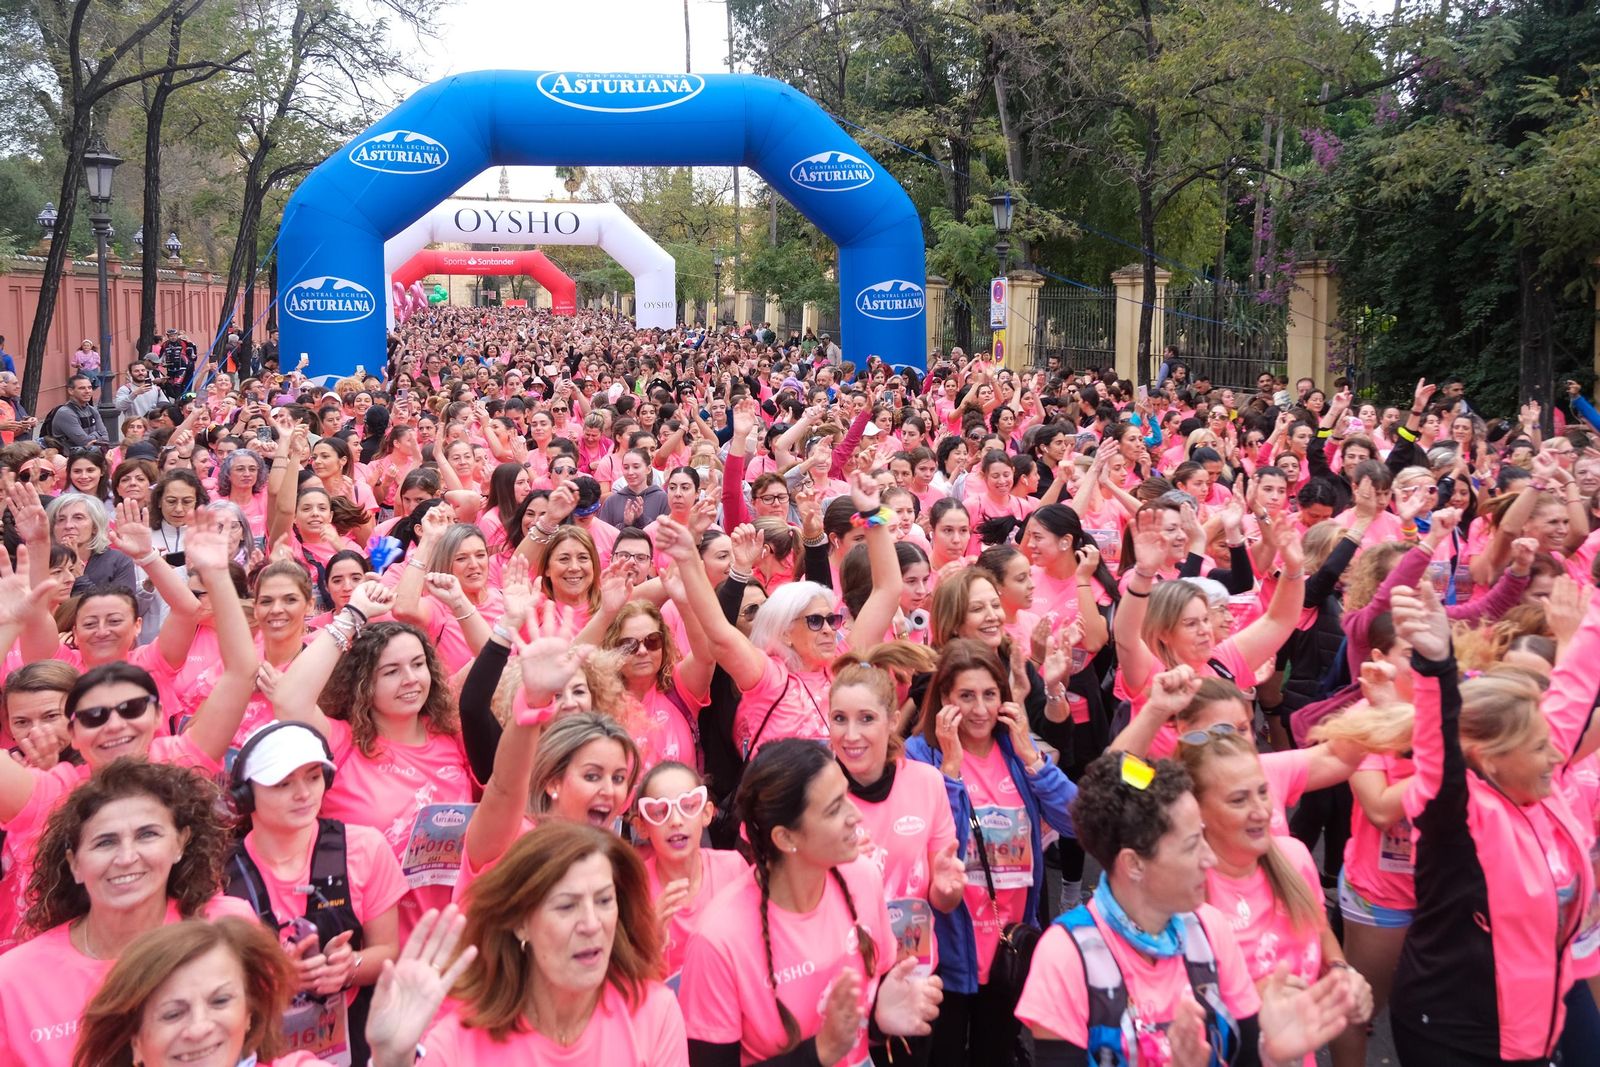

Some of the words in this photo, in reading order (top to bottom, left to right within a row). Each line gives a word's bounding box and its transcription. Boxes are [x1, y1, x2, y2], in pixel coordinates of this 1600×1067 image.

[551, 74, 694, 94] ASTURIANA
[356, 147, 441, 164] ASTURIANA
[797, 167, 870, 182] ASTURIANA
[454, 208, 580, 234] OYSHO
[443, 257, 467, 266] Sports
[289, 293, 371, 311] ASTURIANA
[643, 301, 674, 309] OYSHO
[426, 840, 455, 852] 016
